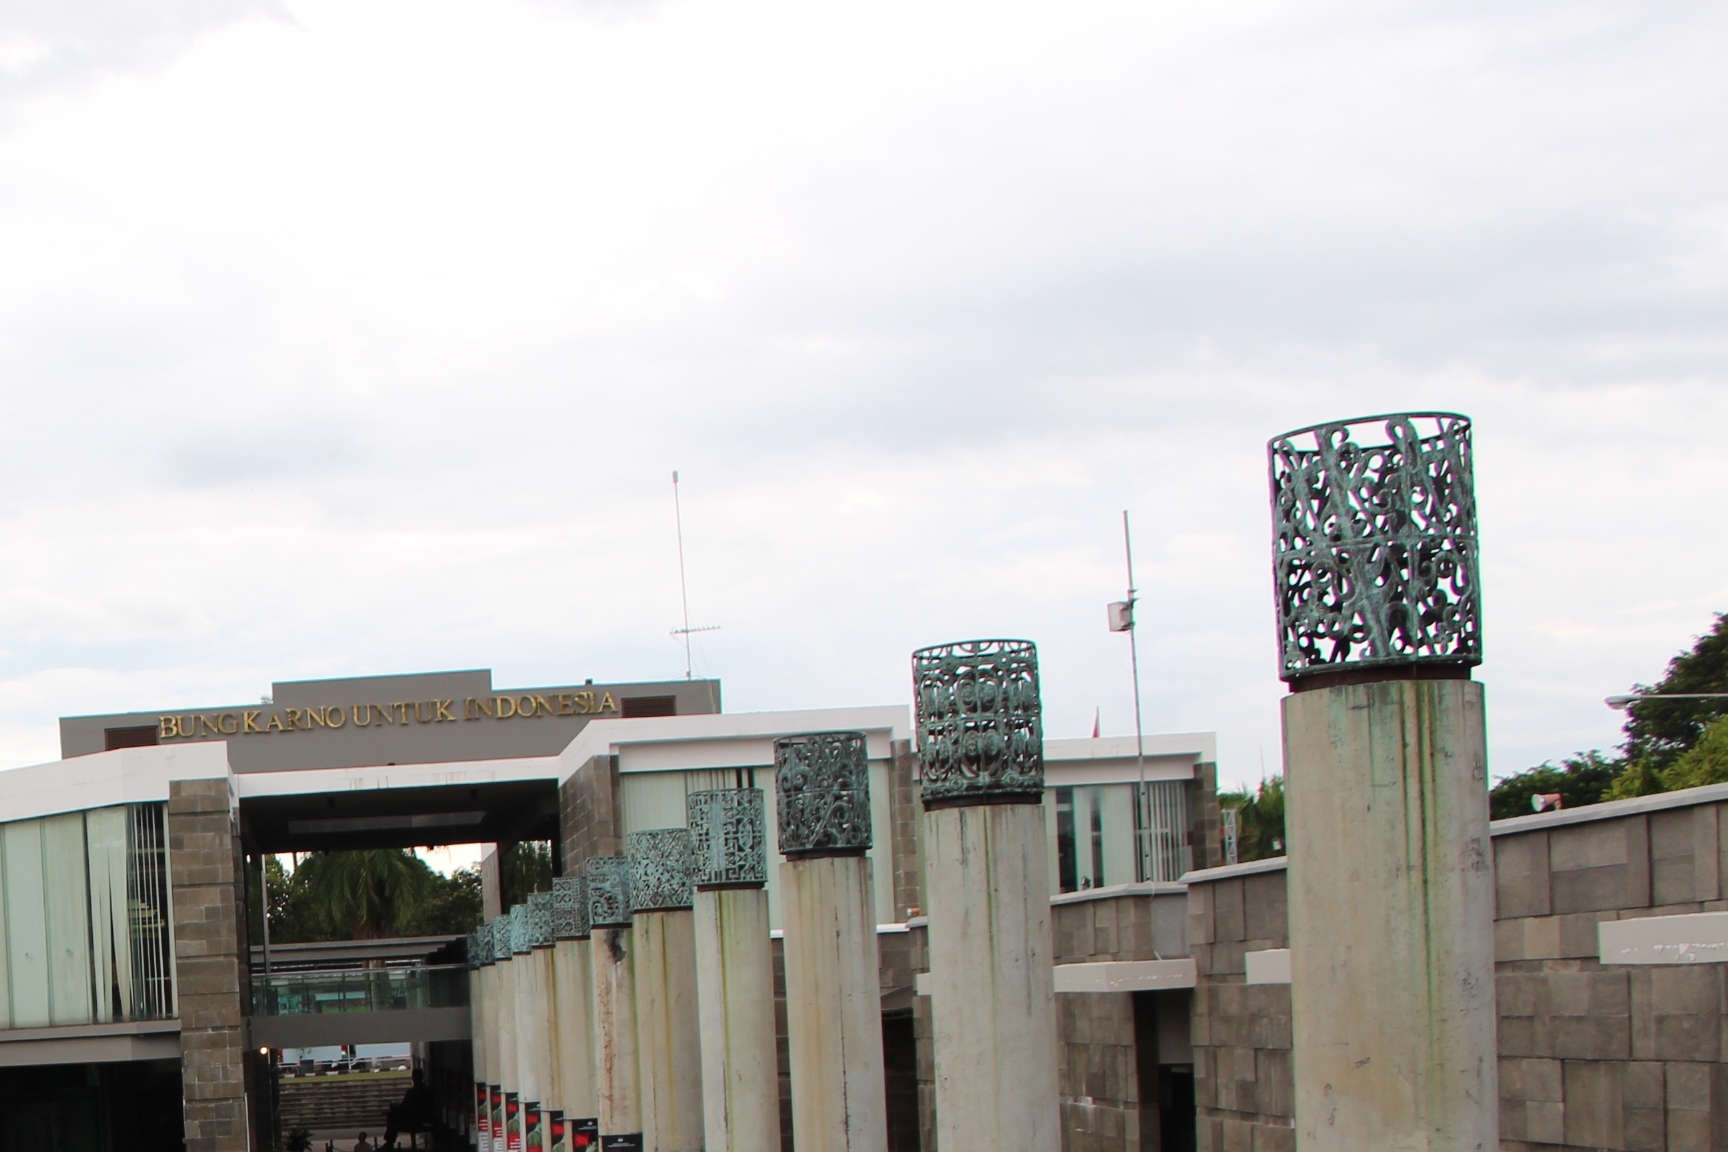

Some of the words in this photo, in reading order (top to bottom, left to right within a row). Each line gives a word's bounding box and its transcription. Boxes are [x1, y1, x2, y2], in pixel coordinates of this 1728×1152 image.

[160, 711, 239, 739] BUNG
[241, 703, 347, 733] KARNO
[352, 698, 458, 727] UNTUK
[462, 690, 619, 721] INDONESIA
